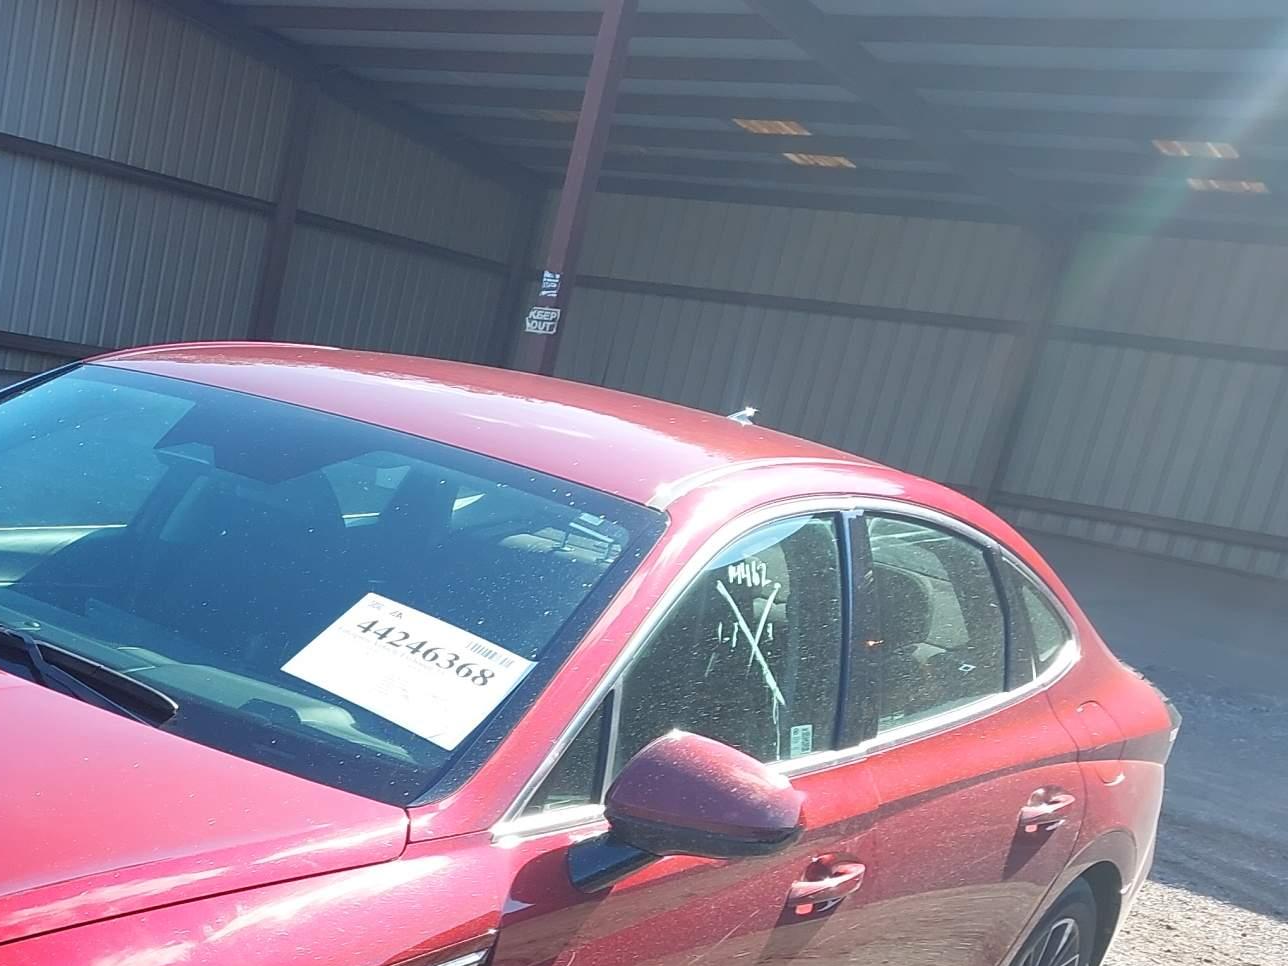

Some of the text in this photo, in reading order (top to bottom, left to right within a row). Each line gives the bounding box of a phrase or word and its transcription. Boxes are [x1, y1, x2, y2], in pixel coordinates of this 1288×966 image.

[529, 310, 557, 321] KEEP
[530, 320, 553, 332] OUT
[357, 619, 495, 686] 44246368
